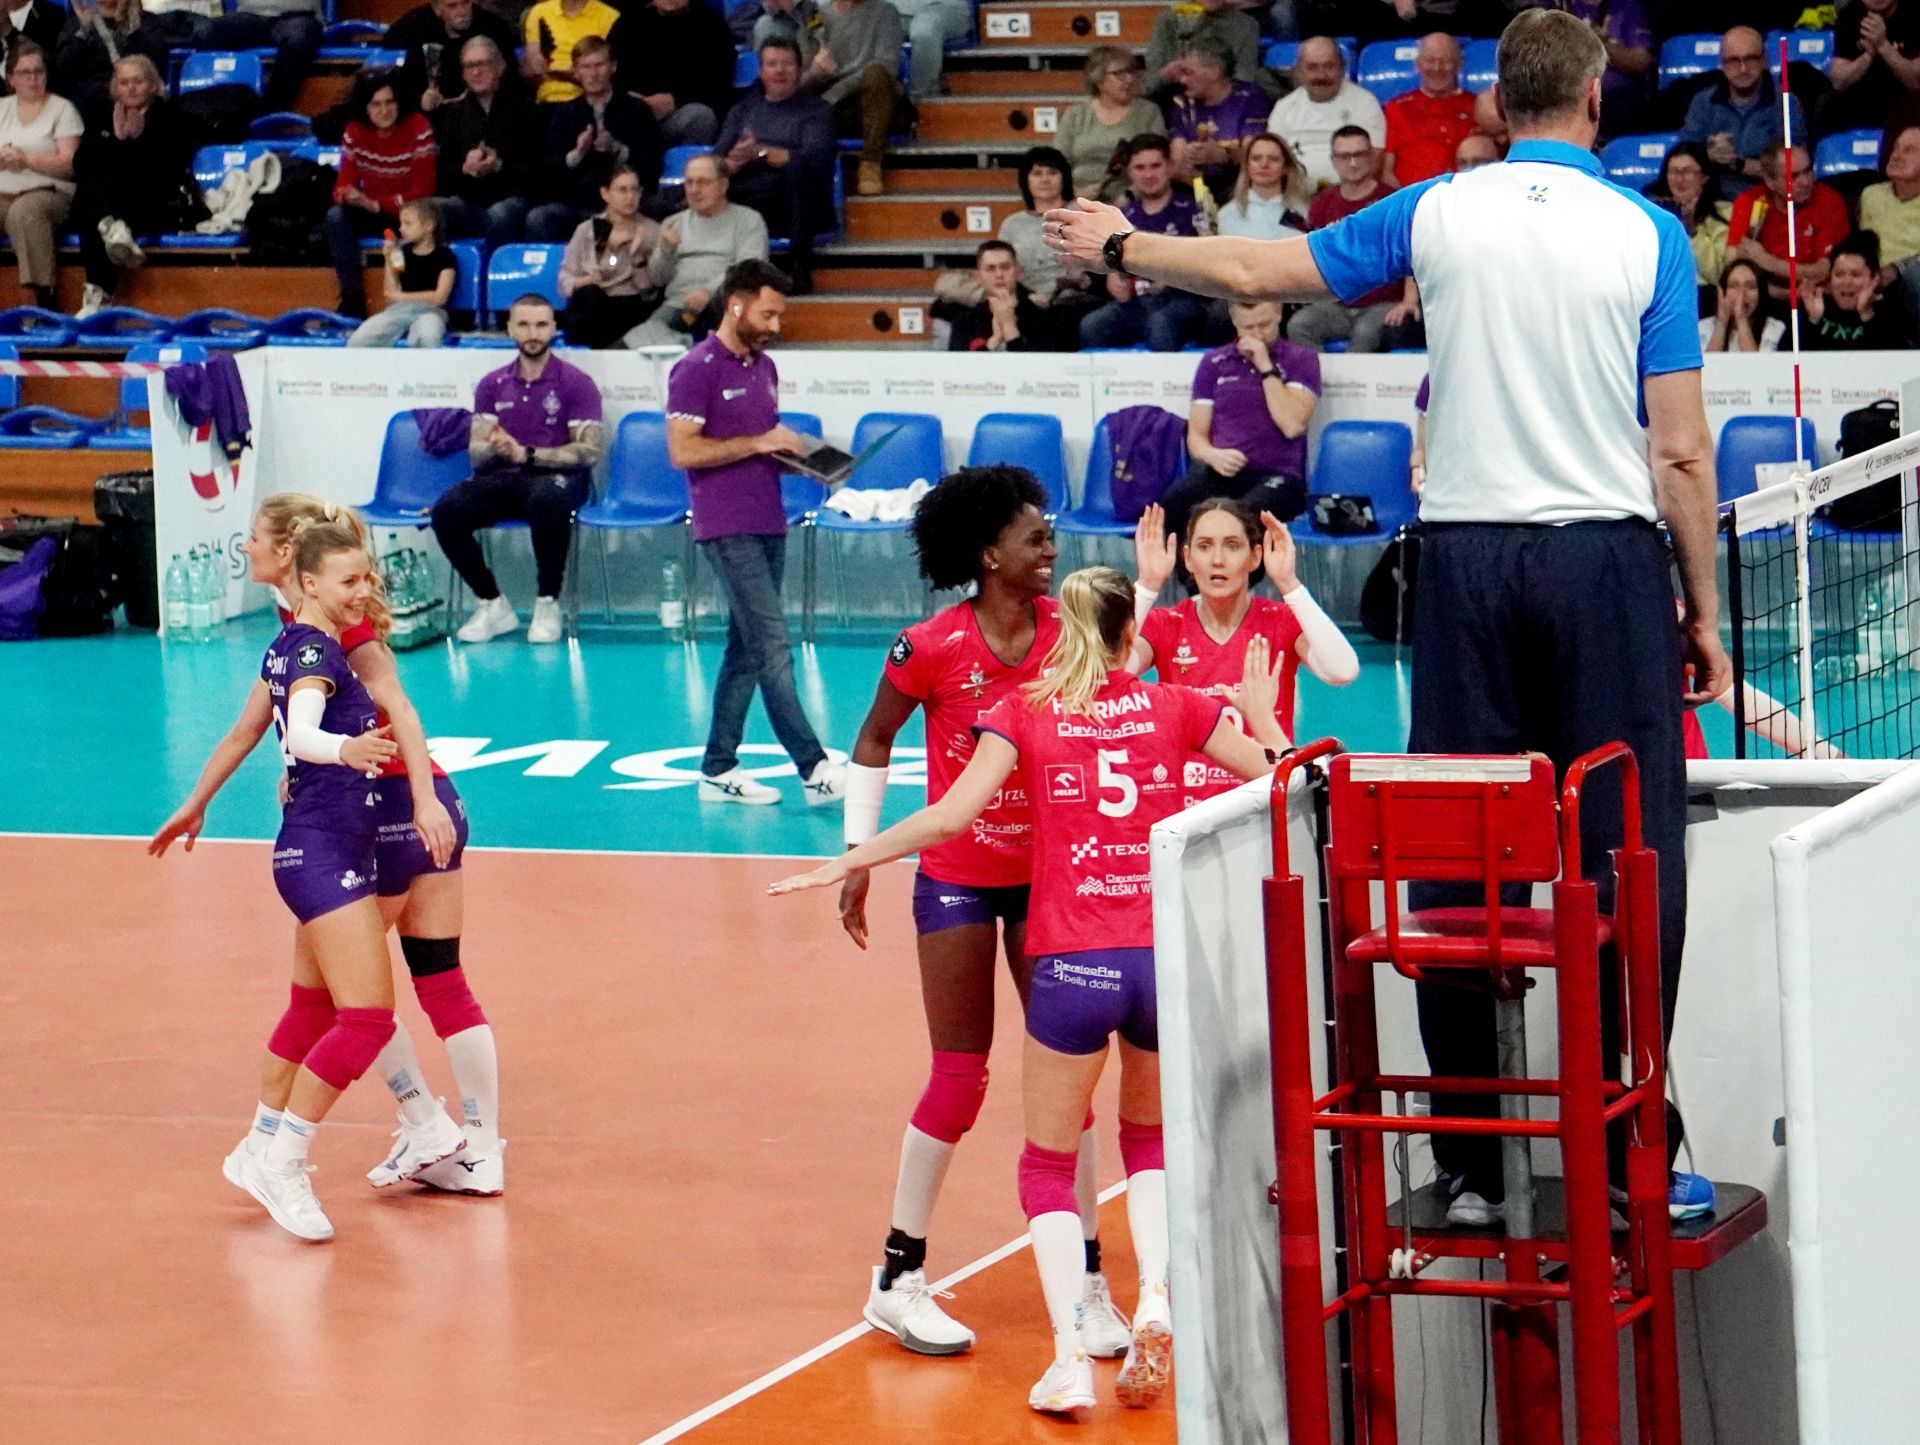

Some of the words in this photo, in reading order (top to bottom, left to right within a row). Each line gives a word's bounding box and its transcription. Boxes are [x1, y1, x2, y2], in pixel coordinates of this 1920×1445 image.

[1527, 195, 1547, 203] CEV
[1818, 475, 1832, 494] CEV
[1053, 691, 1152, 718] HRMAN
[1057, 720, 1156, 740] DevelopRes
[1053, 788, 1080, 797] ORLEN
[1097, 748, 1138, 818] 5
[1105, 872, 1152, 885] Develop
[1053, 959, 1122, 979] DevelopRes
[1064, 973, 1087, 987] bella
[1088, 979, 1121, 992] dolina
